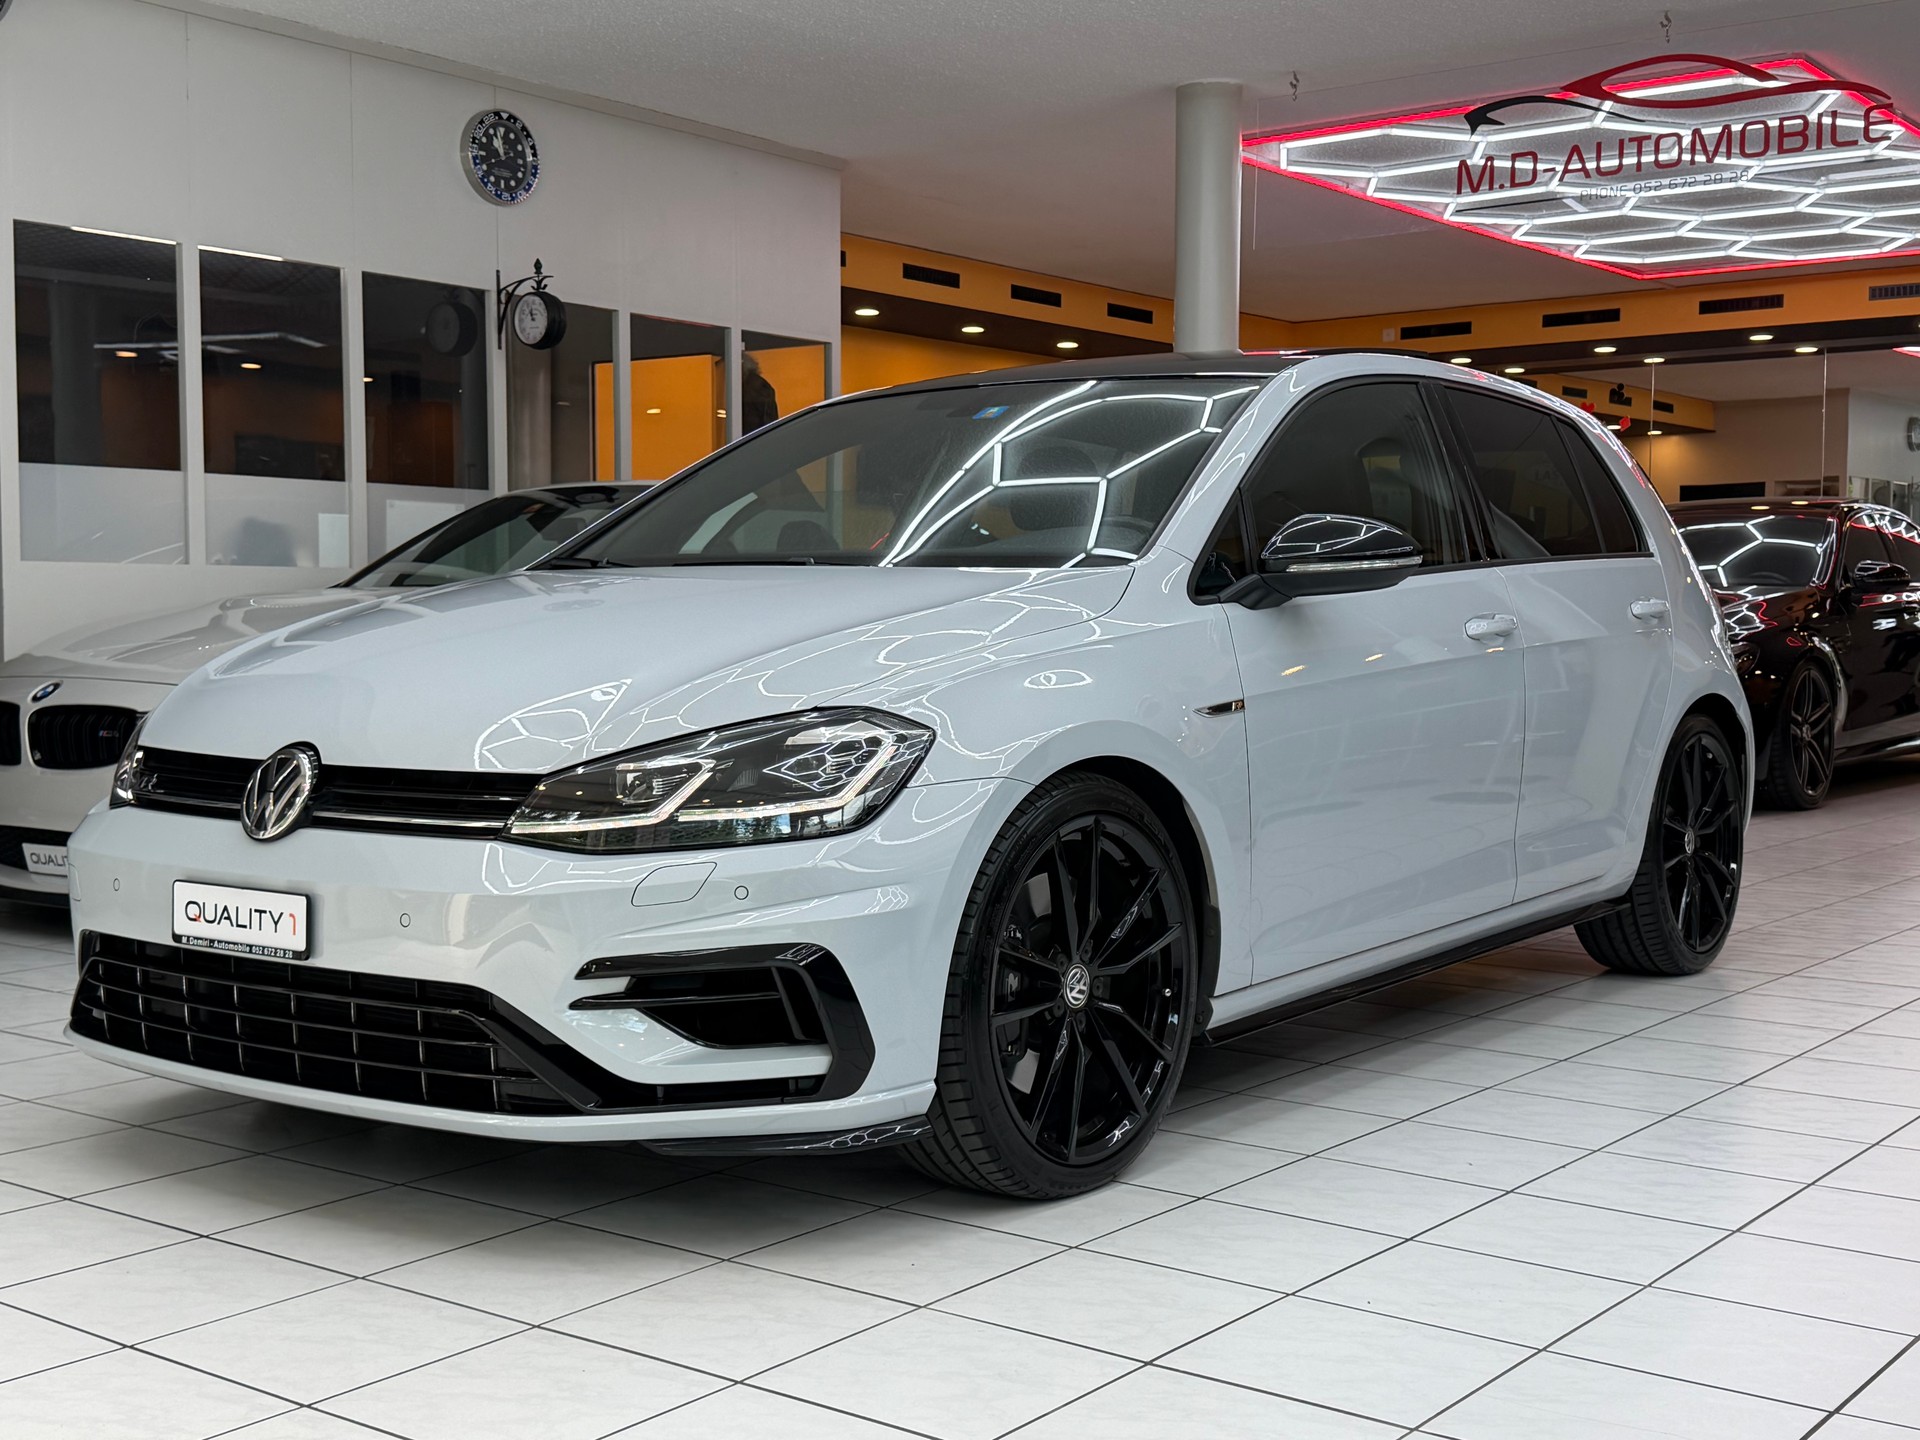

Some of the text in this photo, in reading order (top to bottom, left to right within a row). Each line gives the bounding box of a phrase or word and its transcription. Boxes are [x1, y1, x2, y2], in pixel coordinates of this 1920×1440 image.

[1456, 102, 1894, 195] M.D-AUTOMOBILE
[1580, 170, 1749, 200] PHONE 052 672 28 28
[264, 948, 275, 956] 672
